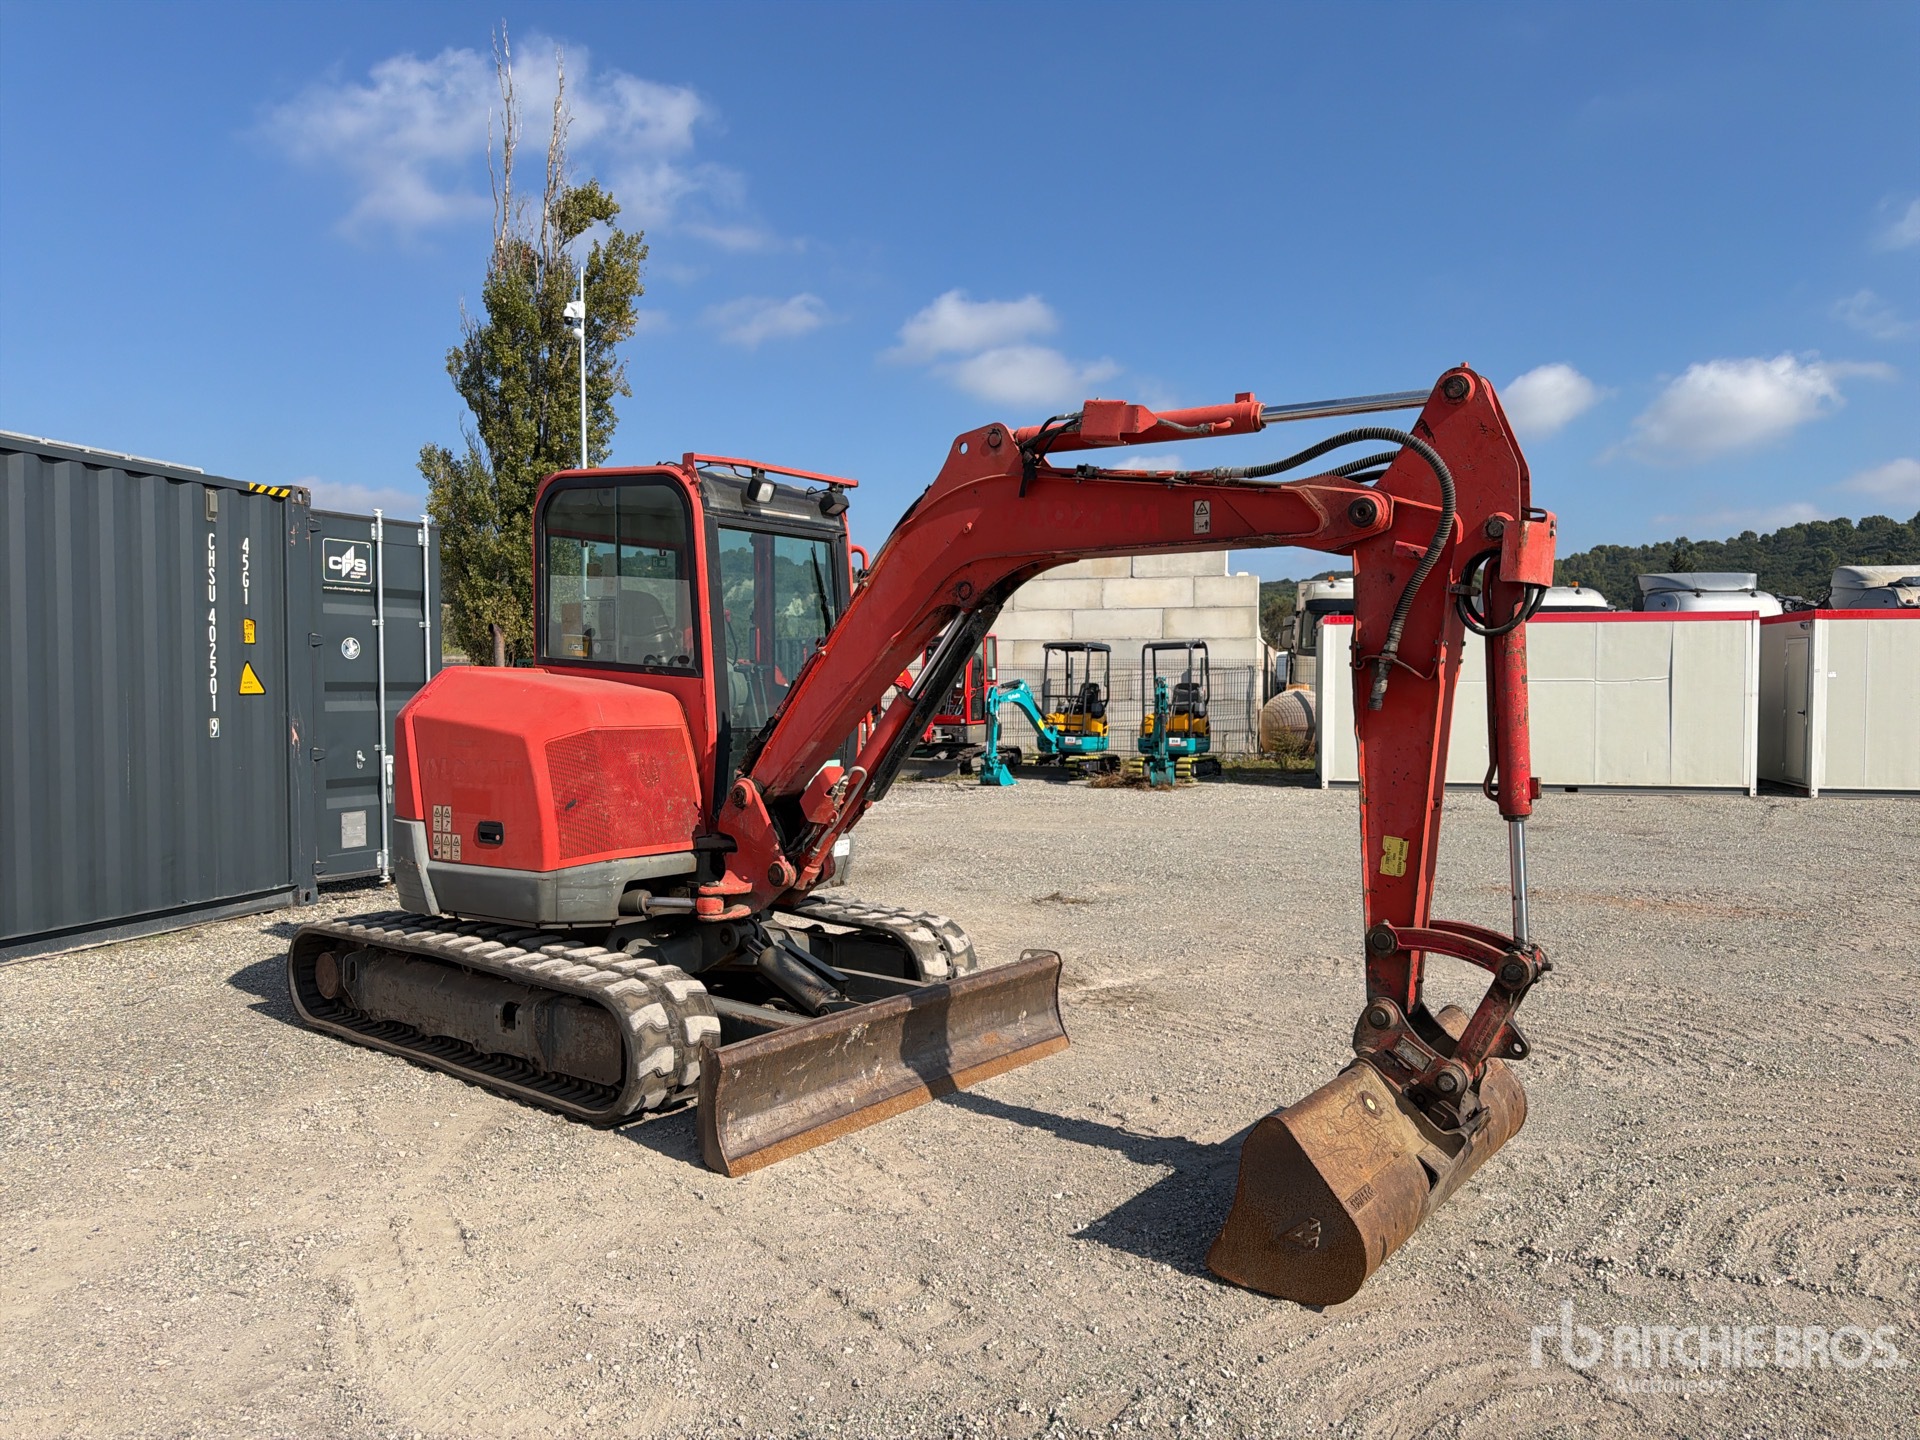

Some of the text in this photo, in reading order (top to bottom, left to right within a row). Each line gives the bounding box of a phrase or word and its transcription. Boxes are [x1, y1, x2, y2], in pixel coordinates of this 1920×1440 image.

[242, 537, 250, 605] 45G1
[328, 545, 367, 578] CHS
[208, 532, 218, 736] CHSU 402501 9
